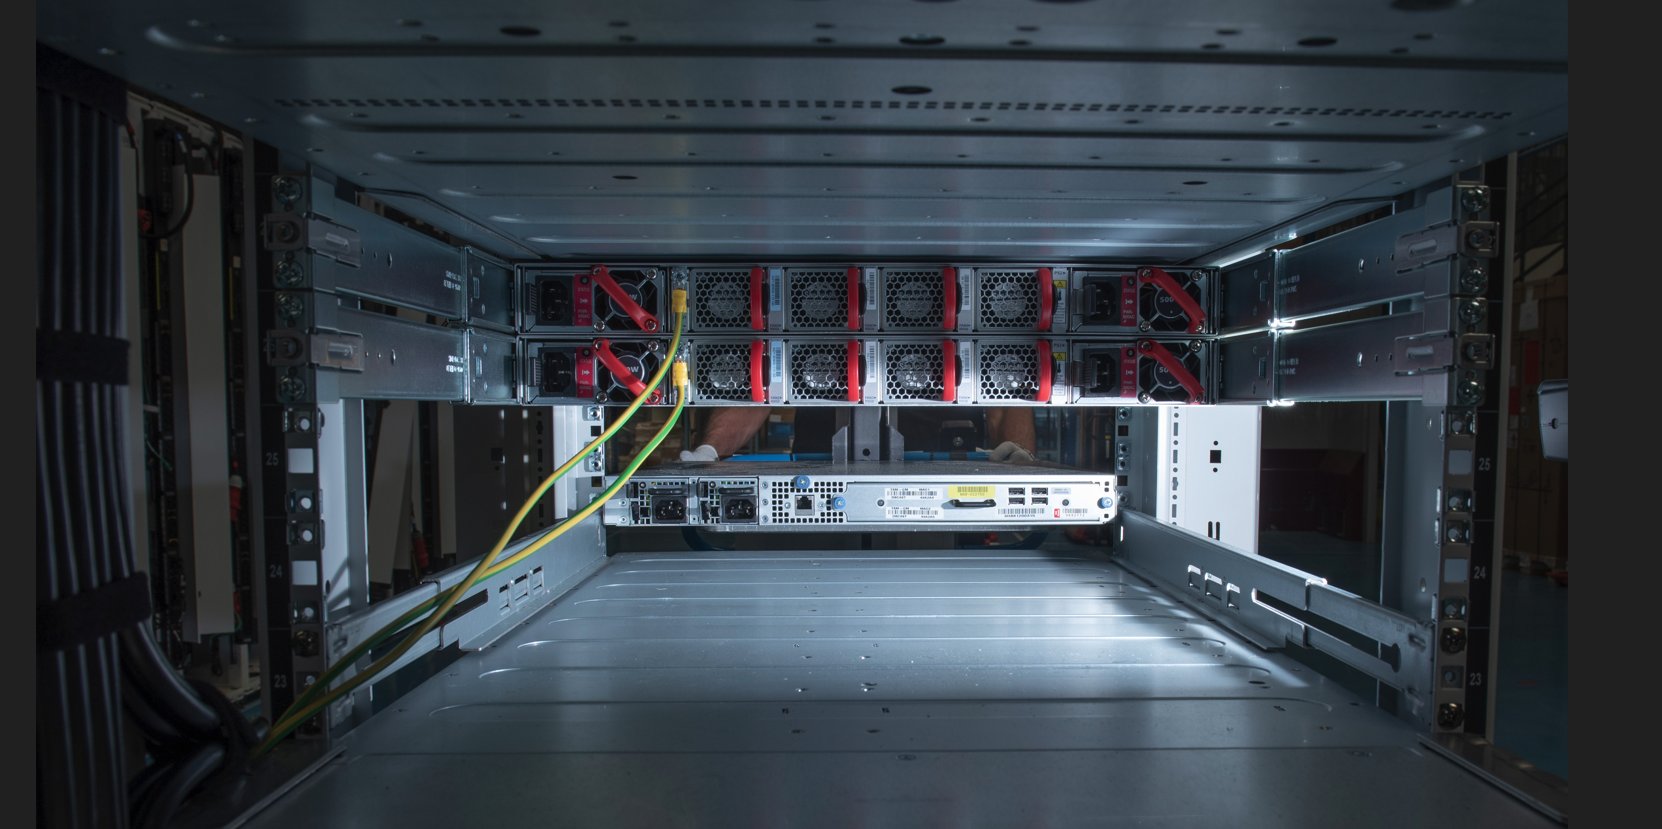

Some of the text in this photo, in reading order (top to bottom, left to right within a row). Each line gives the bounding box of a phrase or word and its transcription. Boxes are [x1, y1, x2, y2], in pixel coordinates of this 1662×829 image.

[265, 451, 279, 466] 25
[1478, 457, 1491, 471] 25
[269, 564, 283, 578] 24
[1473, 565, 1486, 579] 24
[274, 674, 288, 688] 23
[1469, 672, 1482, 686] 23
